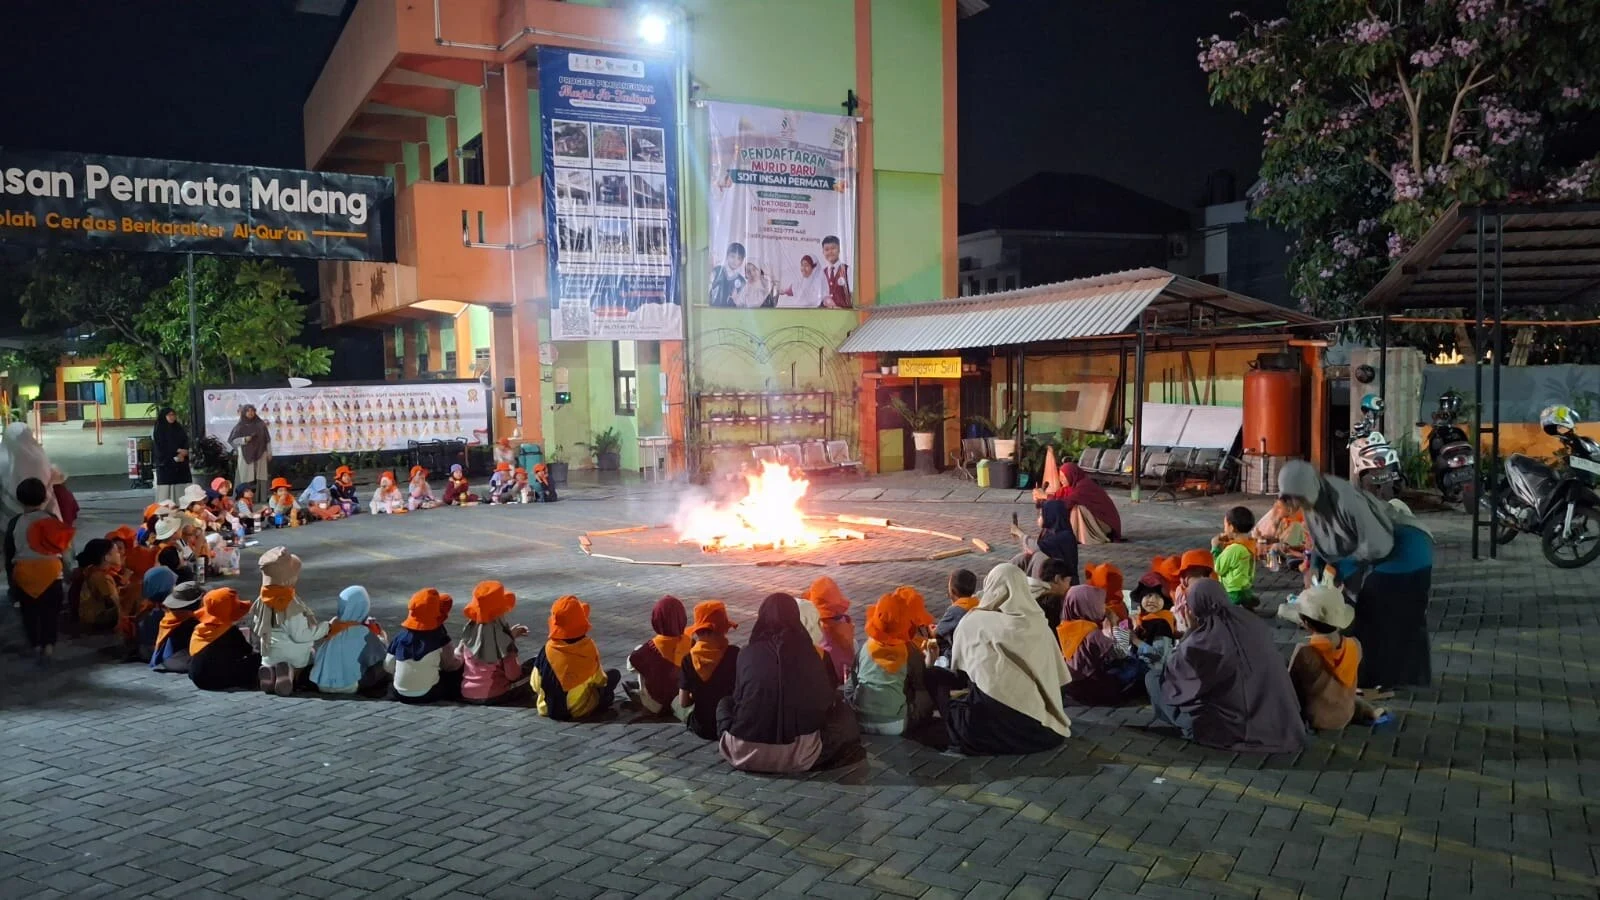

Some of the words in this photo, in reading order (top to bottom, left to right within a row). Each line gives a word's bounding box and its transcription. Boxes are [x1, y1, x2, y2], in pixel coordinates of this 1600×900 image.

[740, 147, 826, 168] PENDAFTARAN
[751, 160, 787, 174] MURID
[790, 163, 816, 177] BARU
[759, 174, 787, 186] INSAN
[788, 177, 829, 189] PERMATA
[0, 167, 75, 198] san
[86, 164, 241, 209] Permata
[251, 176, 368, 225] Malang
[45, 212, 117, 232] Cerdas
[121, 217, 225, 238] Berkarakter
[233, 223, 308, 241] Al-Qur'an
